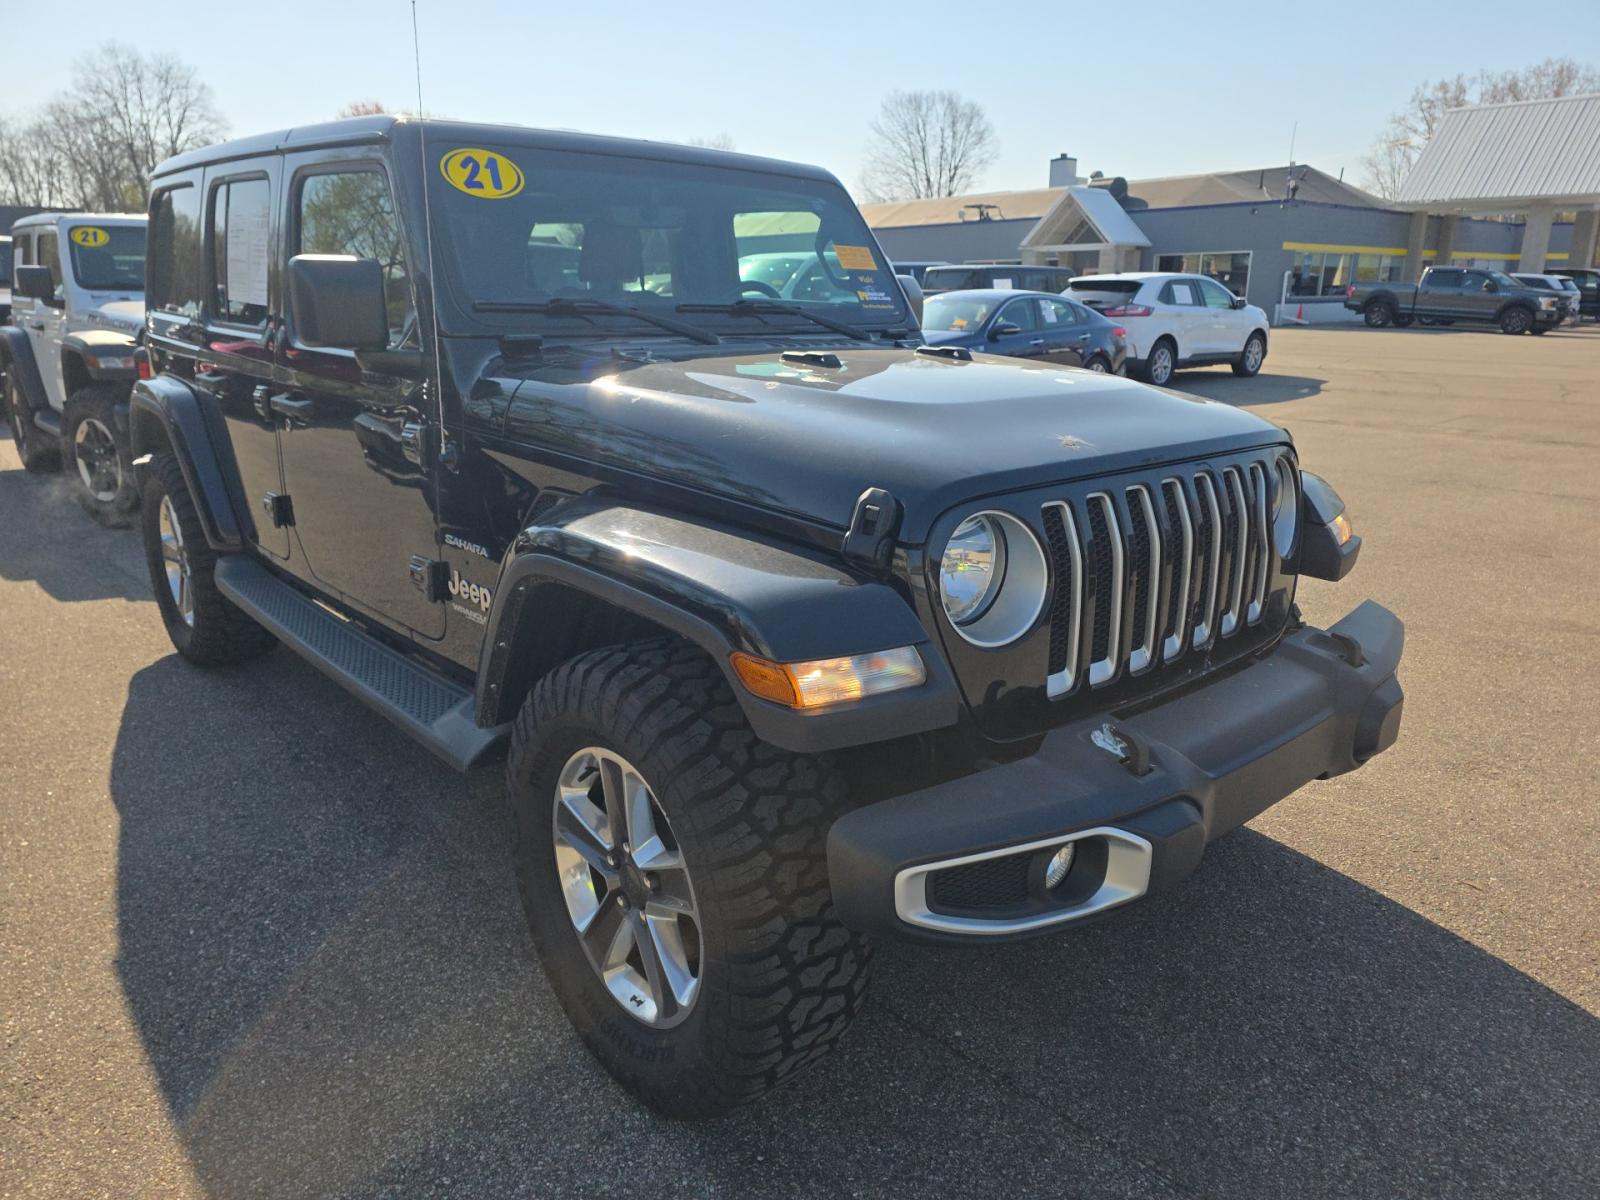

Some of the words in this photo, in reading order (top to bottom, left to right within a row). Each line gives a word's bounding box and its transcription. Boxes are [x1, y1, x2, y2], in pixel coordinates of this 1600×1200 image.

[460, 156, 503, 190] 21
[80, 230, 98, 243] 21
[444, 534, 488, 557] SAHARA
[447, 569, 491, 612] Jeep
